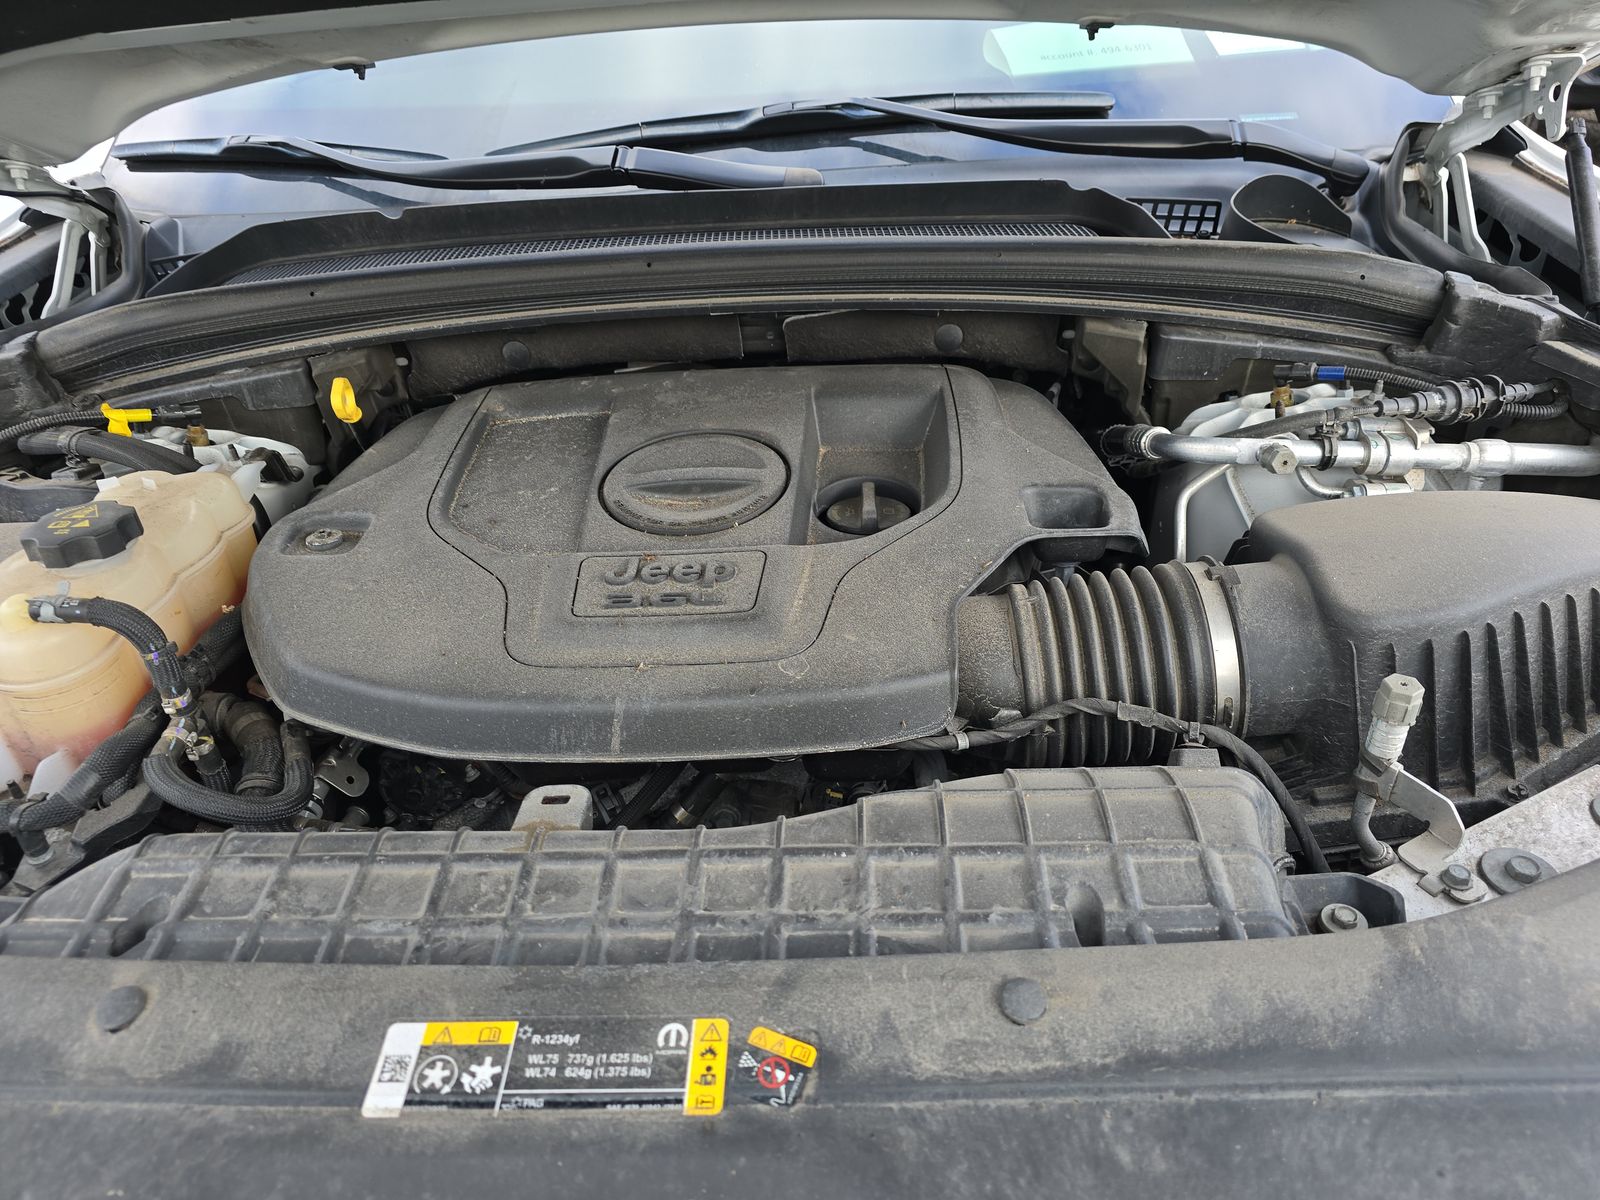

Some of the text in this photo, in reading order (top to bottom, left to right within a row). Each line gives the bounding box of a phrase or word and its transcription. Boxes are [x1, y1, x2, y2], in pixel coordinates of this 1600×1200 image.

[604, 557, 737, 588] Jeep
[531, 1033, 581, 1047] R-1234yf
[527, 1052, 654, 1067] WL75 737g (1.625 lbs)
[524, 1066, 652, 1080] WL74 624g (1.375 lbs)
